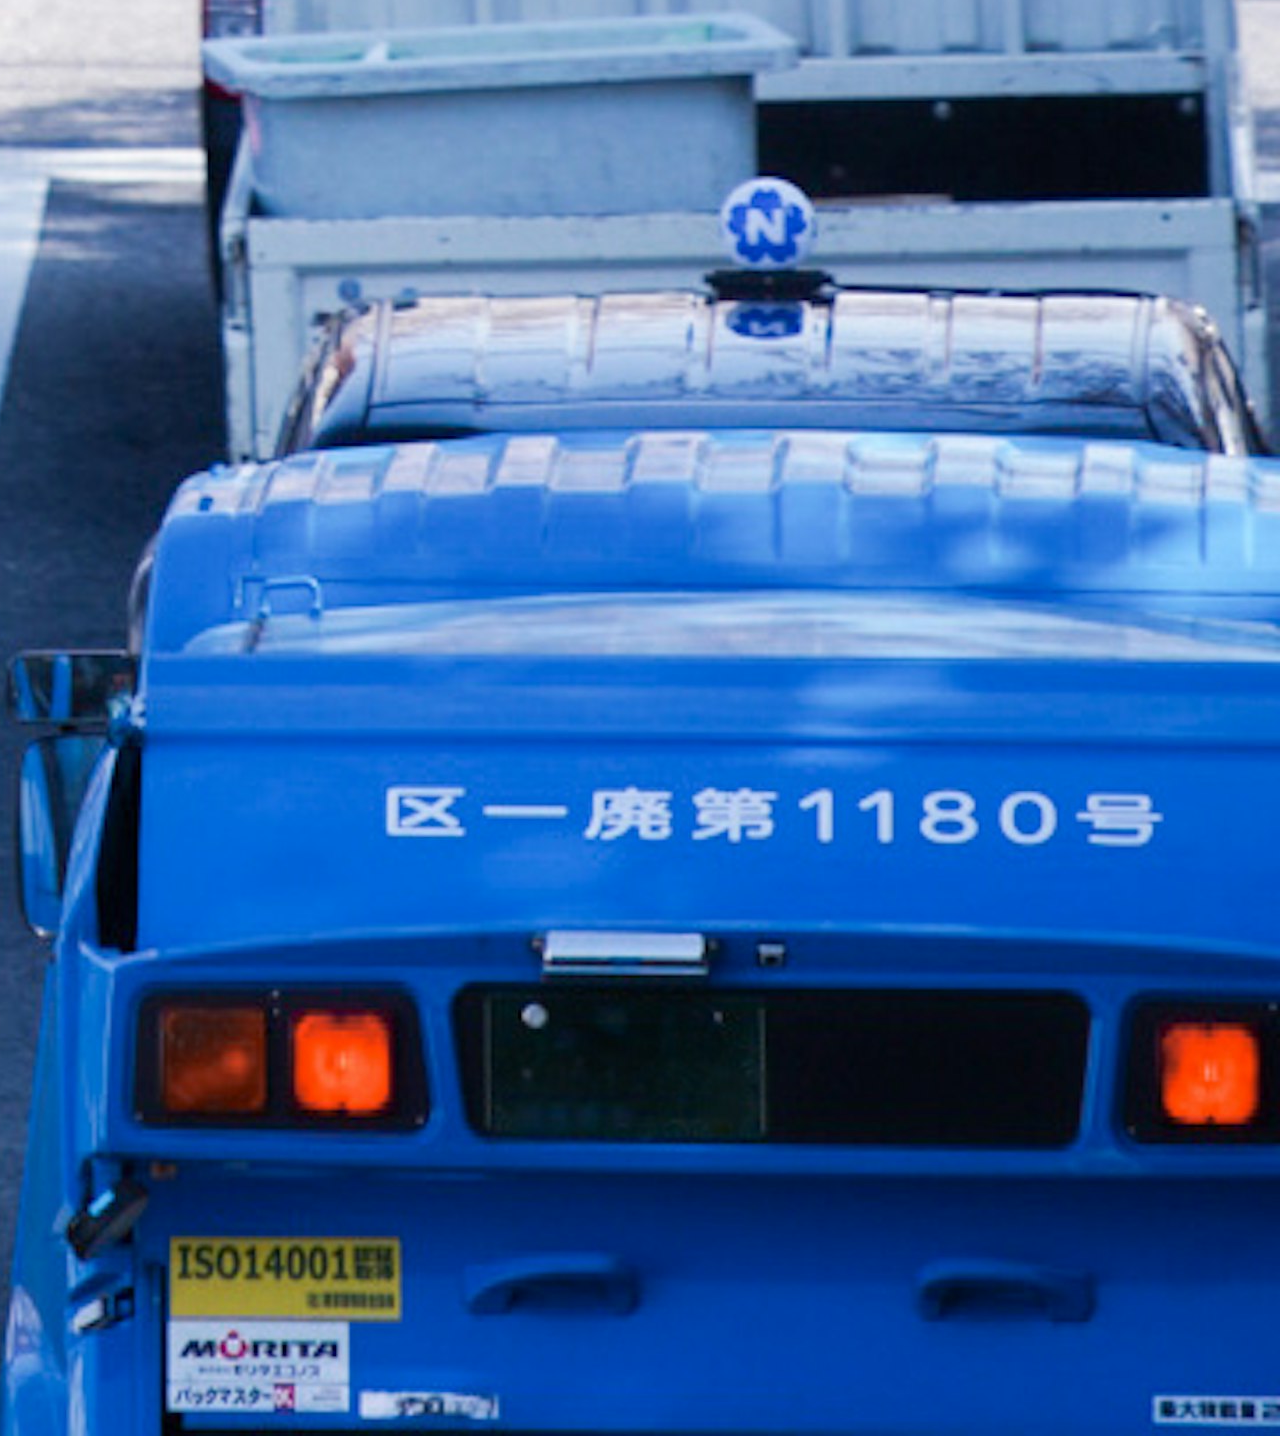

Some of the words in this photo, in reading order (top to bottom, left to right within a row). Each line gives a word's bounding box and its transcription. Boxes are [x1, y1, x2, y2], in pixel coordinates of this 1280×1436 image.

[745, 207, 786, 246] N
[385, 786, 1163, 847] 区一廃第1180号
[177, 1246, 349, 1280] ISO14001
[180, 1330, 338, 1358] MORITA
